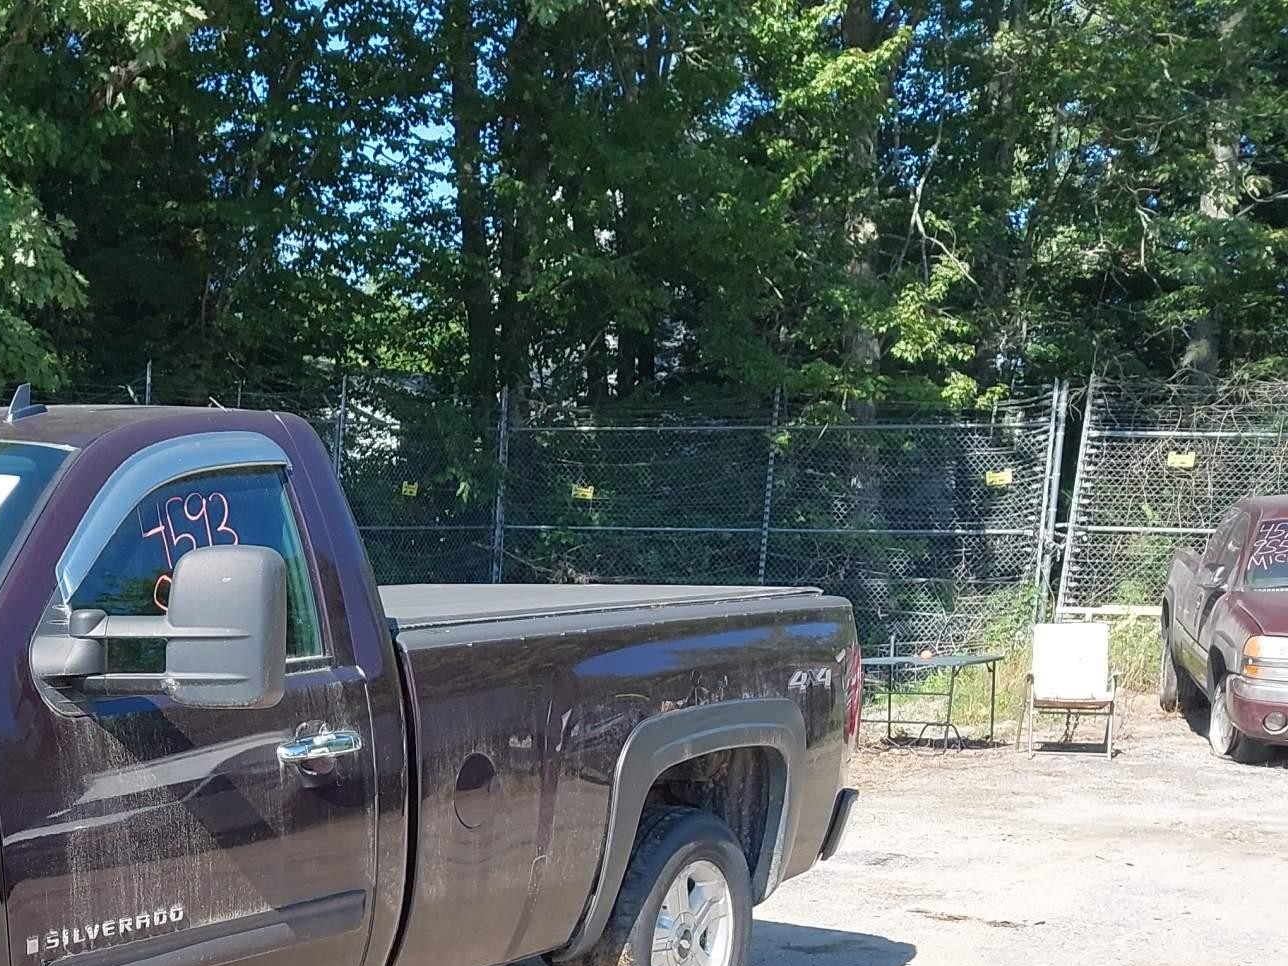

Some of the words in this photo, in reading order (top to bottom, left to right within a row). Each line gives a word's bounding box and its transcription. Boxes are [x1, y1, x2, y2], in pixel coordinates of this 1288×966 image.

[136, 492, 239, 569] 4593
[1259, 522, 1288, 540] 45
[1247, 553, 1288, 570] MIC
[45, 906, 185, 949] SILVERADO
